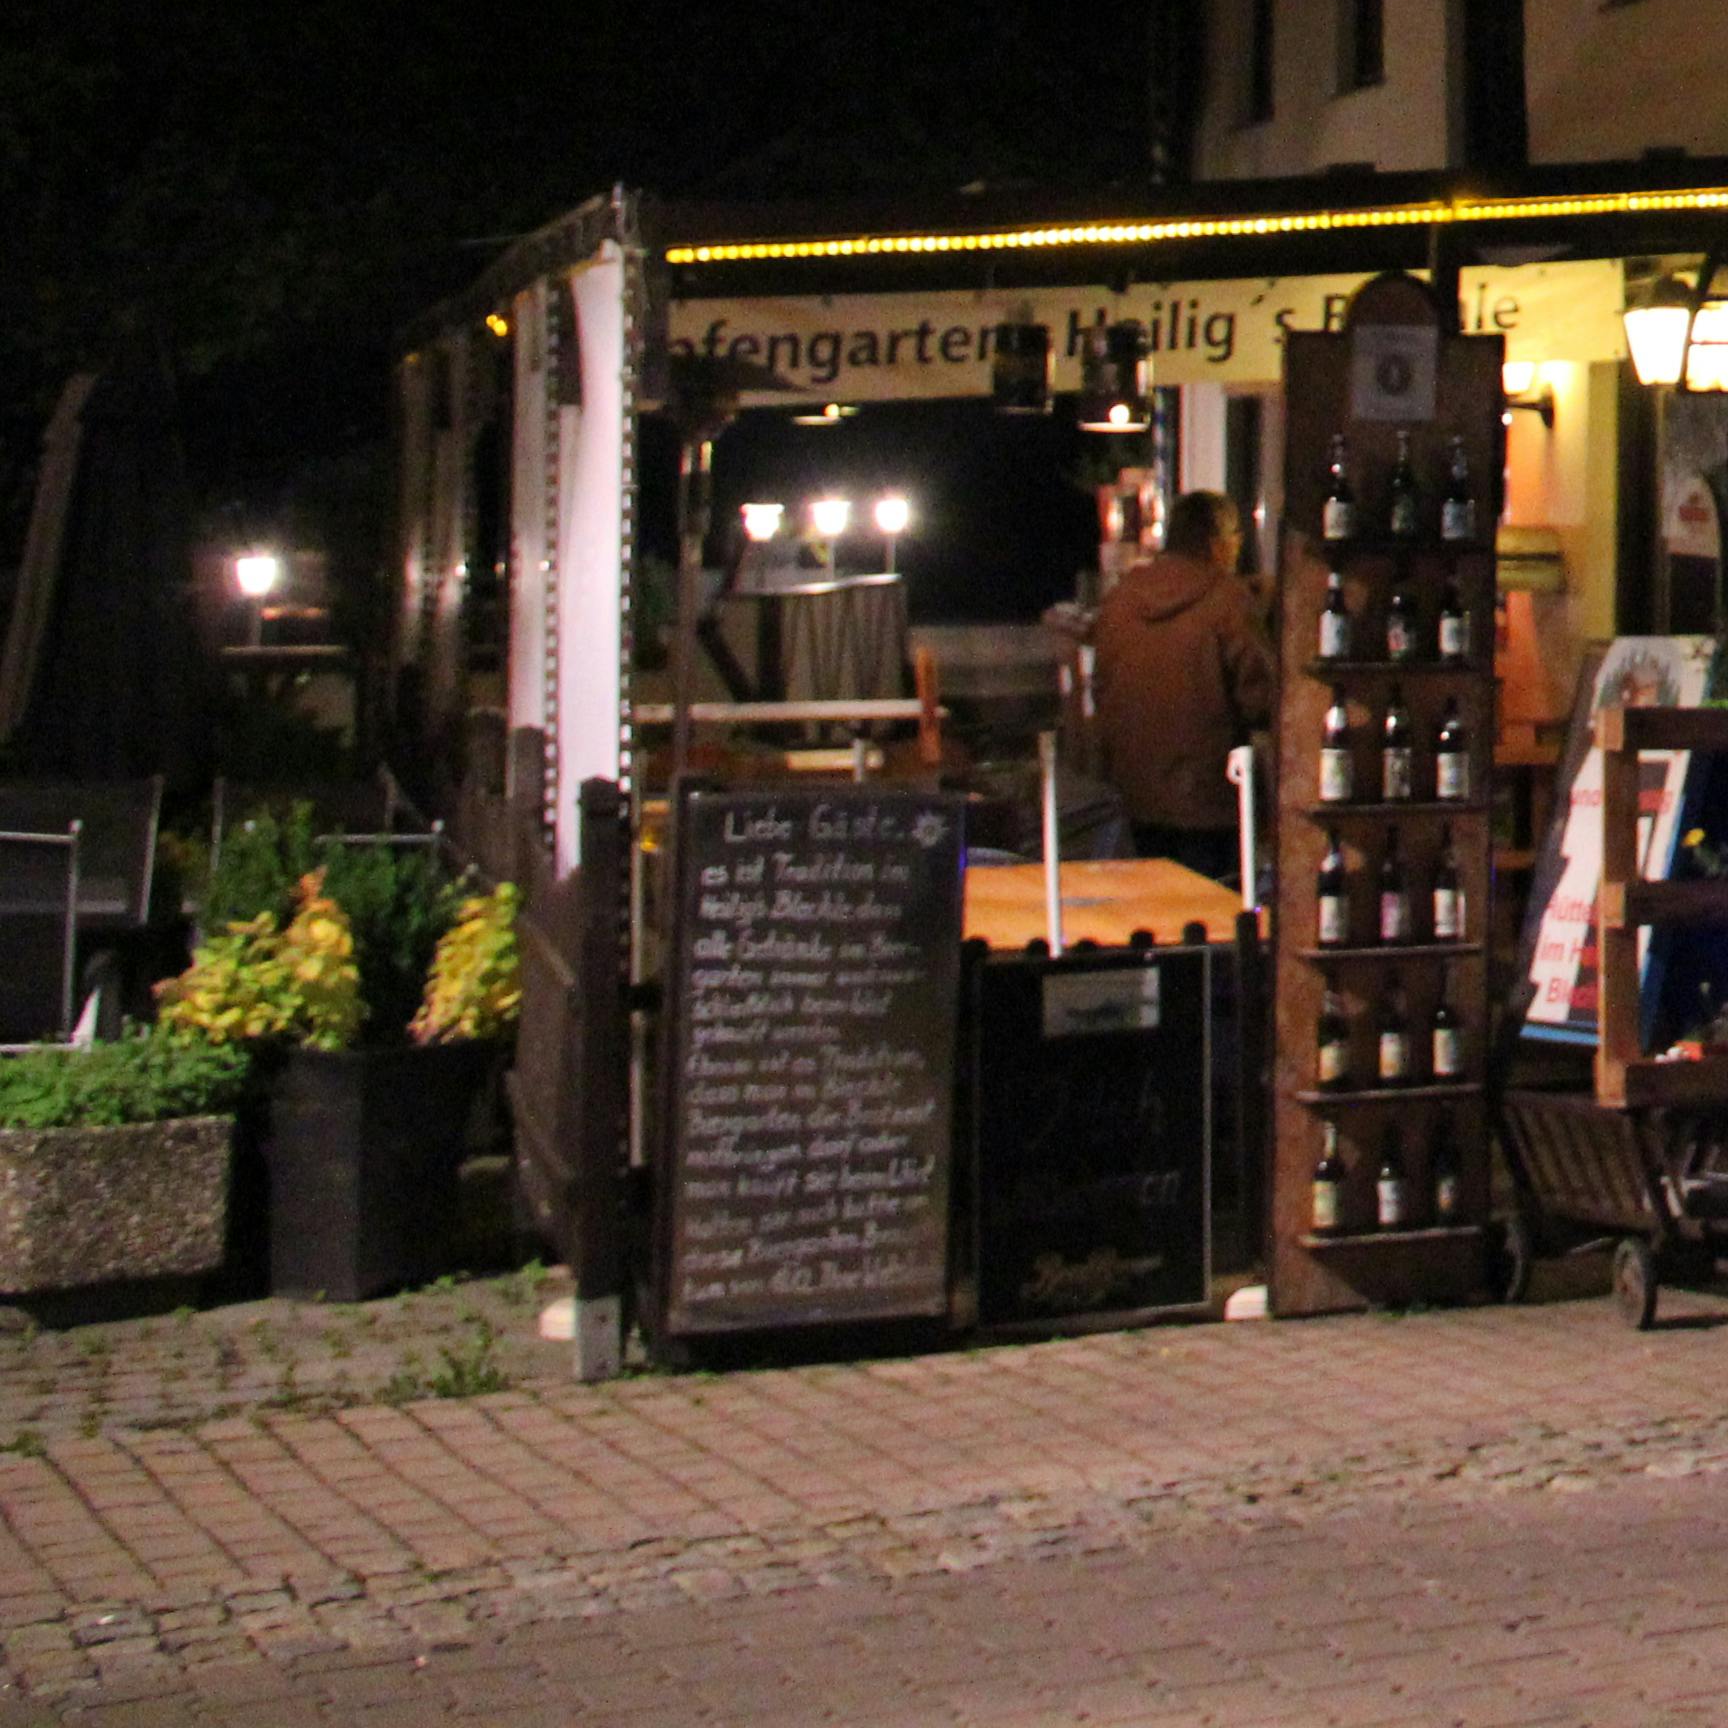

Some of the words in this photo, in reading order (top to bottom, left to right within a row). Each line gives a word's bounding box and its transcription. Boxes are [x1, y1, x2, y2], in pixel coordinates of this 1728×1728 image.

[724, 806, 794, 843] Liebe
[700, 864, 730, 886] es
[734, 854, 765, 883] ist
[772, 850, 875, 882] Tradition
